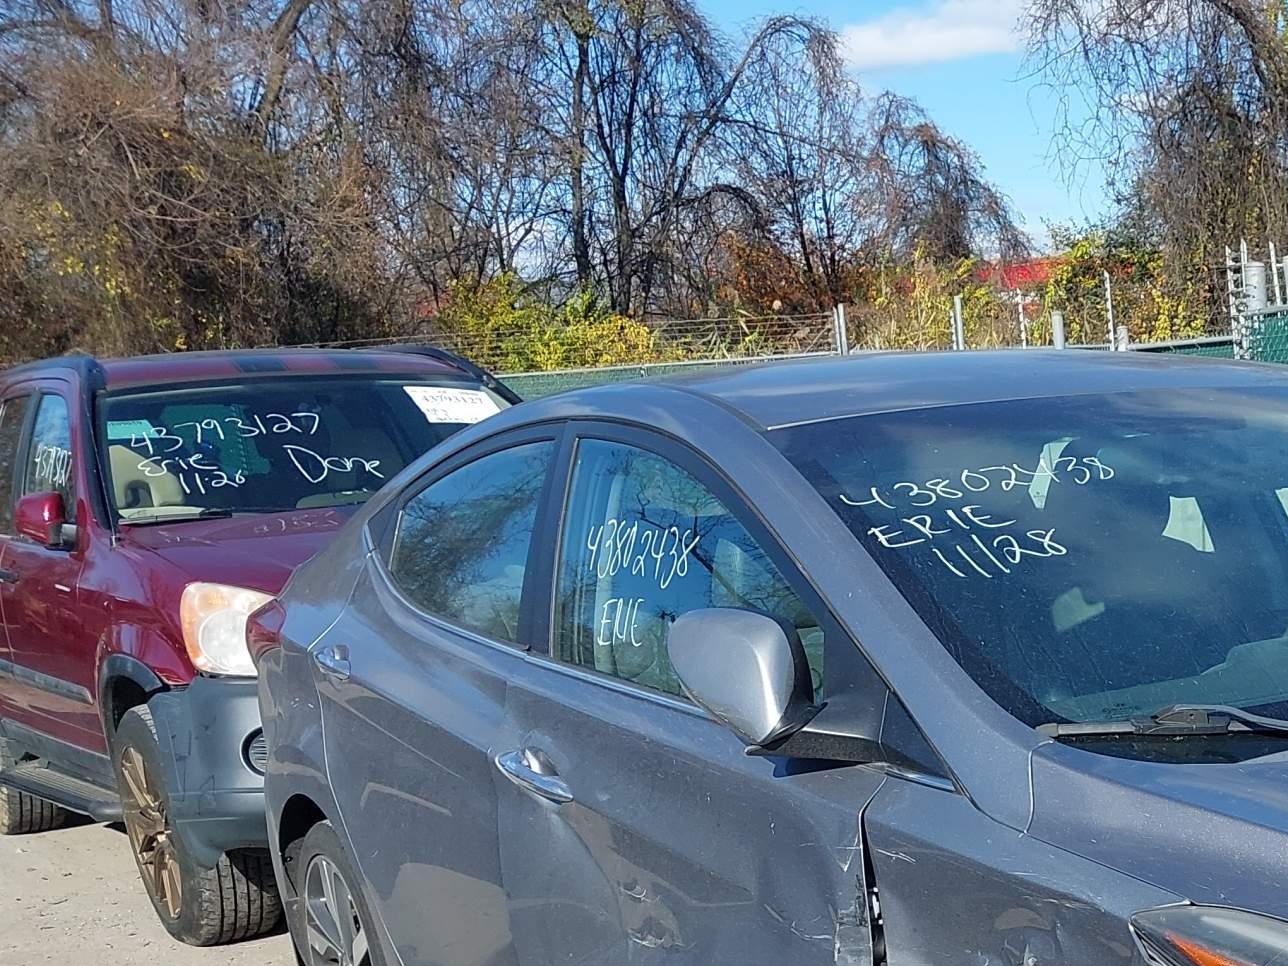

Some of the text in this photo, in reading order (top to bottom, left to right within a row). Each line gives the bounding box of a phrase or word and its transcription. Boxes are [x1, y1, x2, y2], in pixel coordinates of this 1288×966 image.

[131, 413, 320, 454] 43793127
[137, 453, 218, 477] Erie
[283, 445, 385, 483] Done
[839, 456, 1115, 509] 43802438
[867, 505, 1017, 548] ERIE
[586, 518, 701, 590] 43802438
[932, 528, 1068, 578] 11/28
